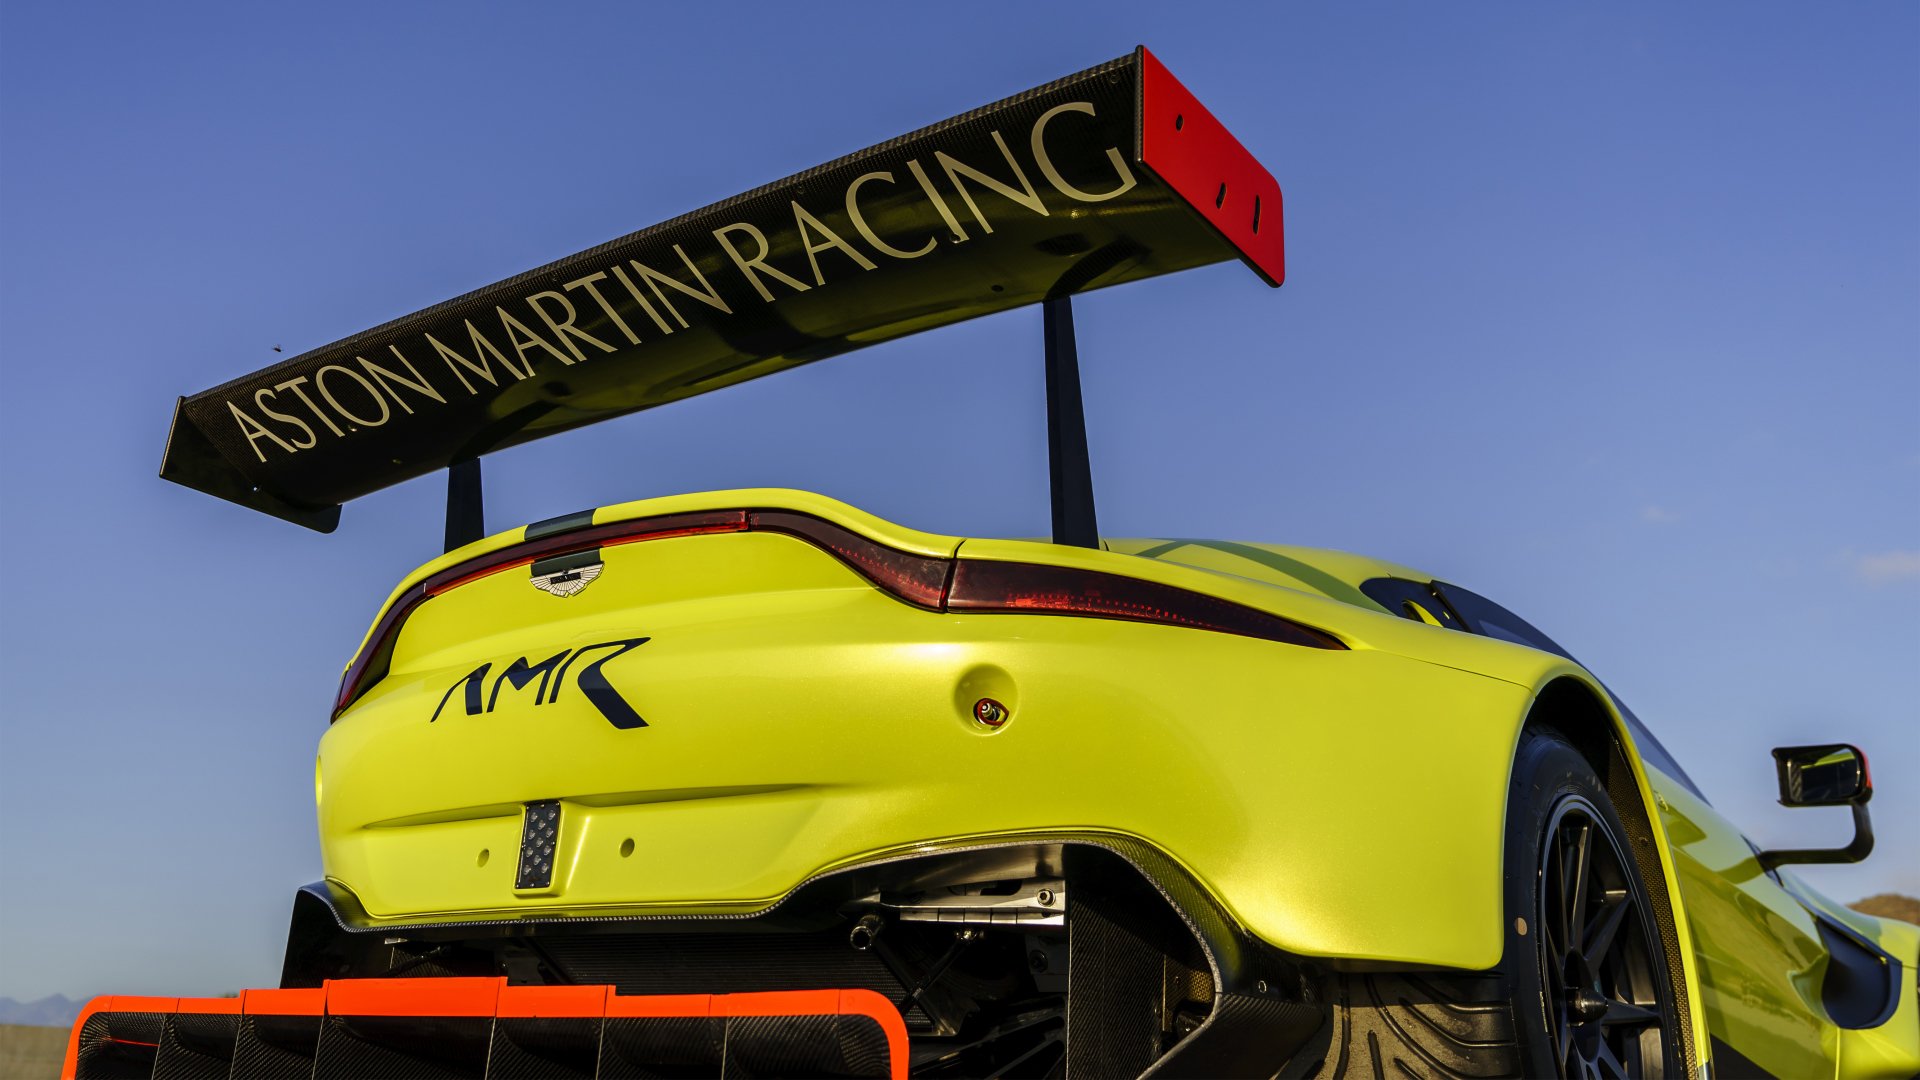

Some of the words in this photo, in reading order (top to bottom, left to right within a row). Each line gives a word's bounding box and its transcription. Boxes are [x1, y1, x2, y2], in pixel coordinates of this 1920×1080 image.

[226, 345, 447, 462] ASTON
[425, 244, 733, 395] MARTIN
[713, 102, 1137, 302] RACING
[430, 637, 652, 729] AMR
